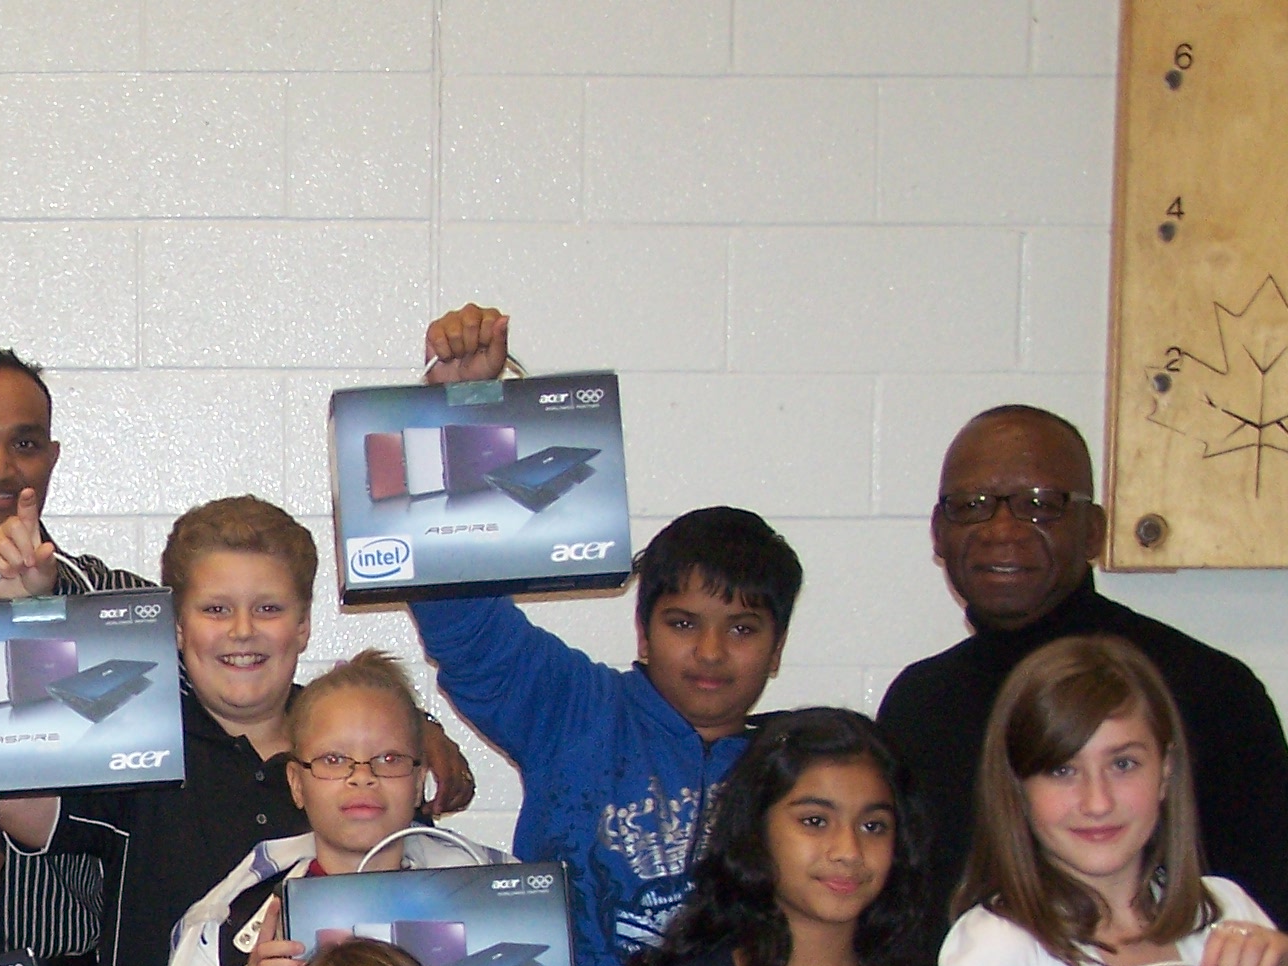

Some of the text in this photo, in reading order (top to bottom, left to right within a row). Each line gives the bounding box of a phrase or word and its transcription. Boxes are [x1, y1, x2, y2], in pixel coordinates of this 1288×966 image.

[1174, 43, 1193, 70] 6
[1166, 196, 1184, 220] 4
[1165, 347, 1182, 371] 2
[425, 523, 499, 535] ASPIRE
[358, 546, 400, 567] intel
[551, 540, 615, 561] acer
[109, 749, 170, 770] acer
